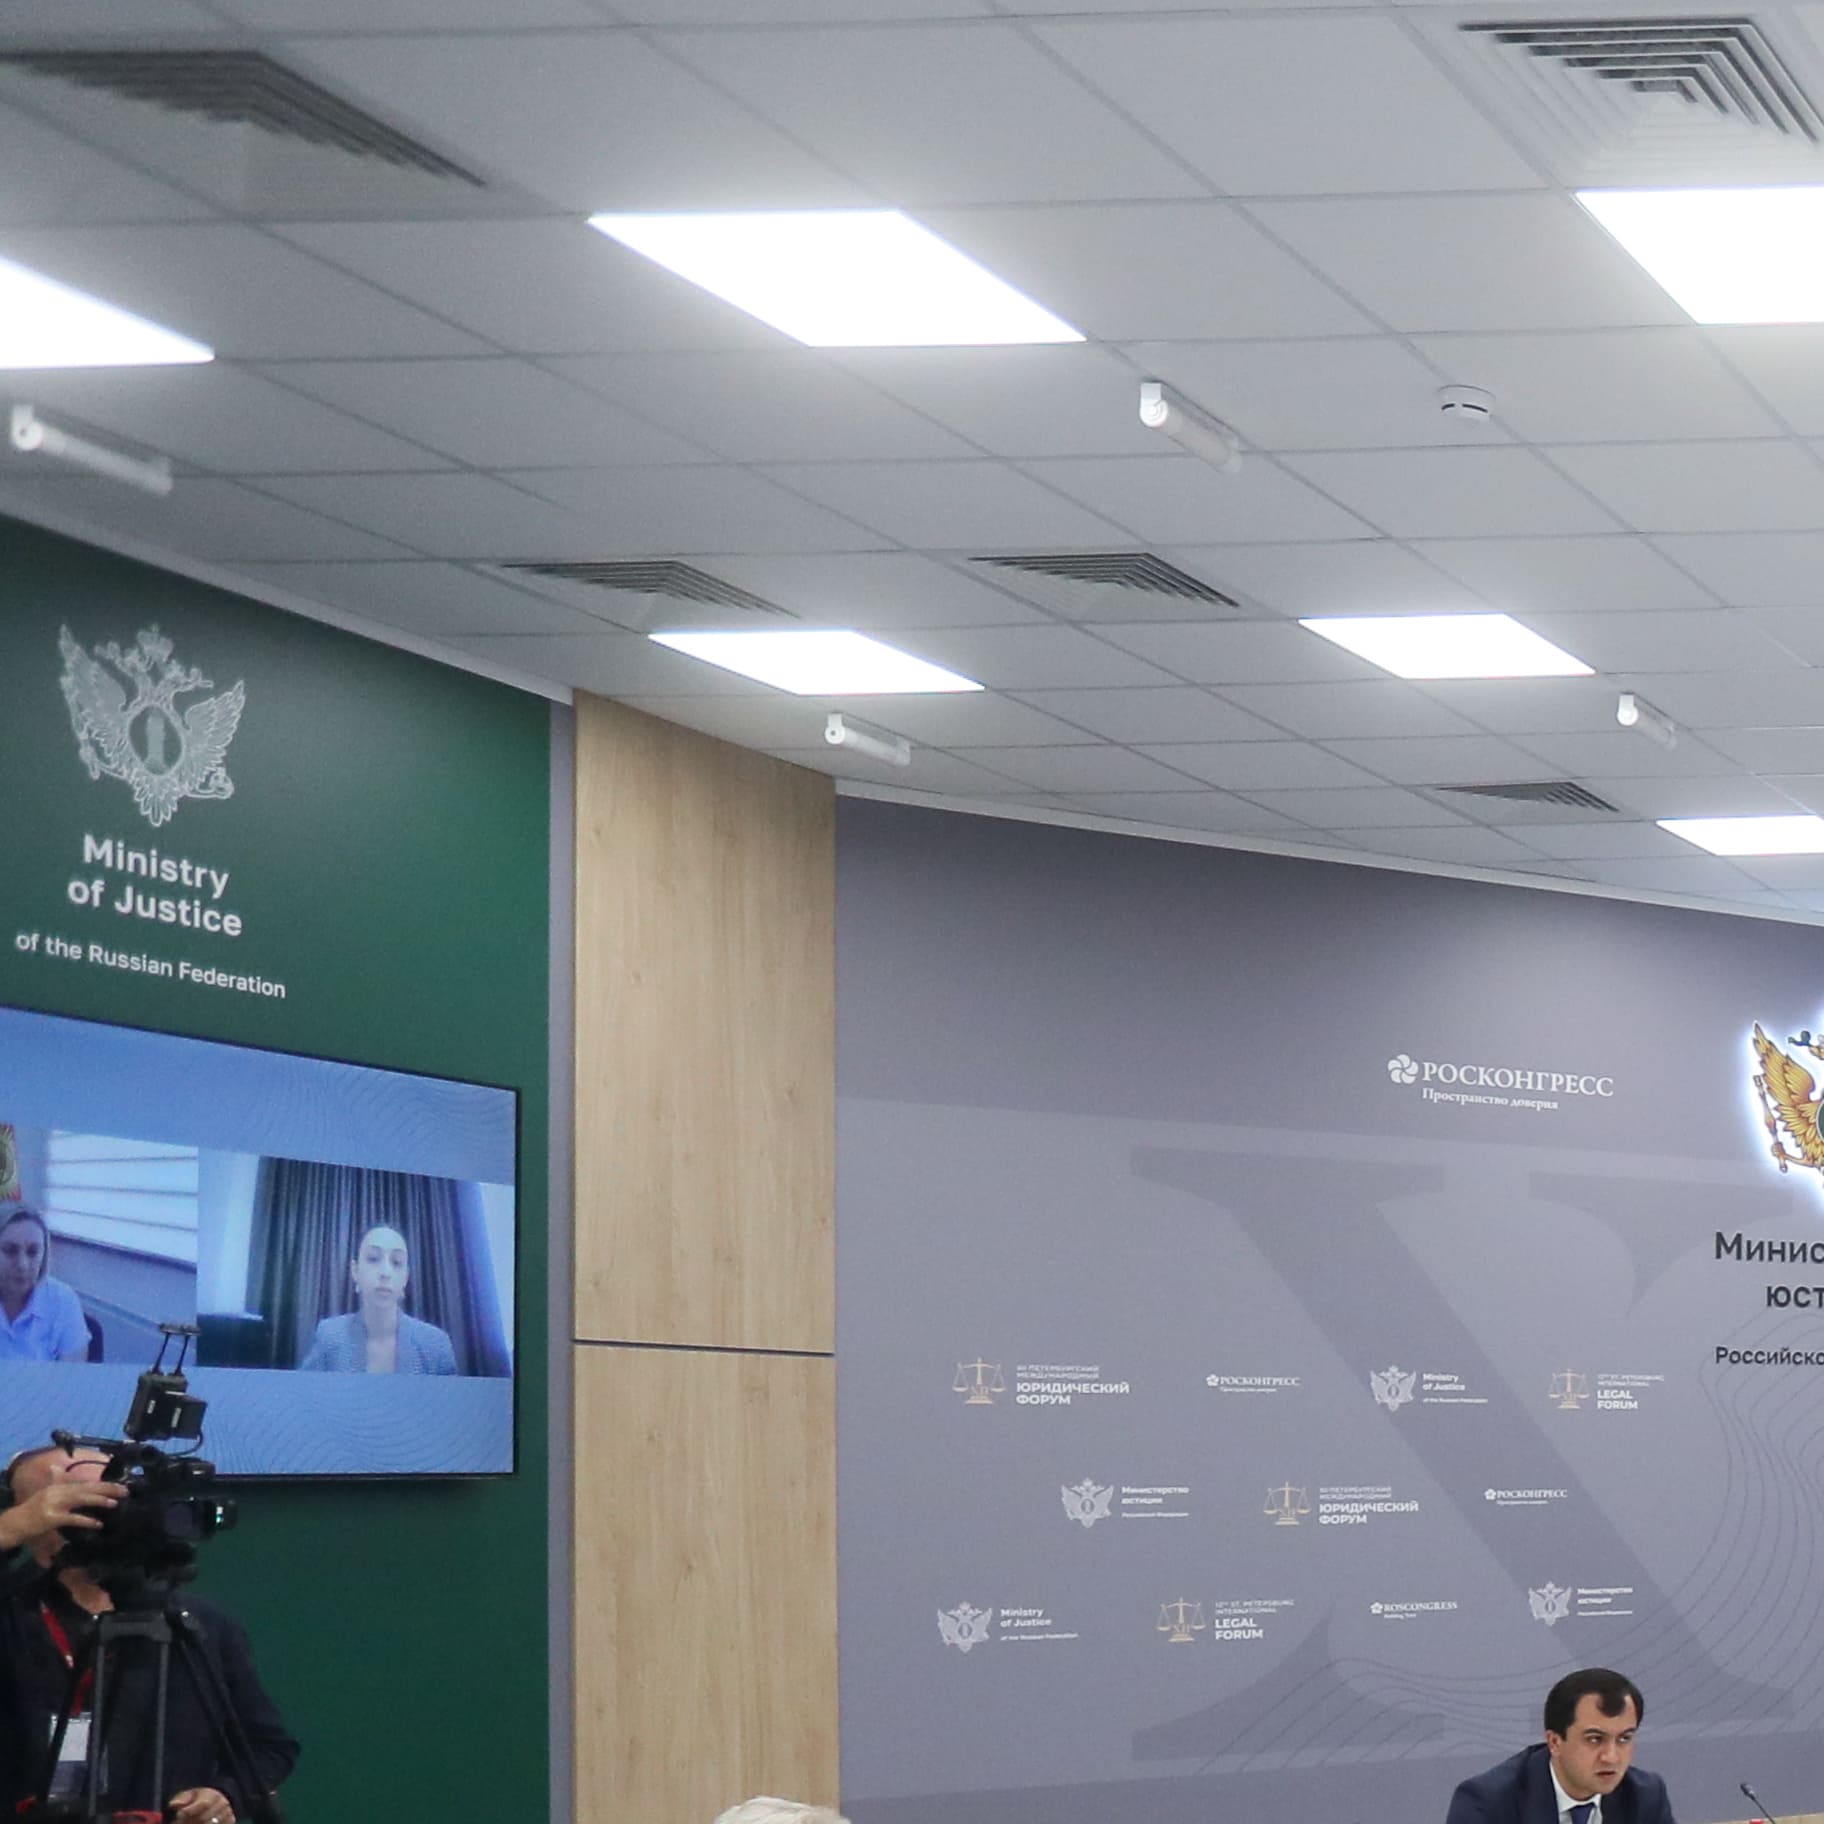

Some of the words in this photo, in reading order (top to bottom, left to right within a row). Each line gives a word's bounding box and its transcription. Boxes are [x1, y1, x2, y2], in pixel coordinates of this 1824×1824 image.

[84, 834, 229, 899] Ministry
[67, 879, 105, 908] of
[114, 886, 242, 936] Justice
[15, 932, 40, 951] of
[45, 936, 82, 960] the
[89, 944, 173, 977] Russian
[178, 961, 286, 999] Federation
[1422, 1062, 1614, 1097] РОСКОНГРЕСС
[1422, 1088, 1508, 1106] Пространство
[1510, 1097, 1558, 1111] доверия
[1017, 1381, 1130, 1393] ЮРИДИЧЕСКИЙ
[1016, 1394, 1071, 1405] ФОРУМ
[1597, 1390, 1633, 1399] LEGAL
[1597, 1400, 1638, 1409] FORUM
[1319, 1500, 1419, 1514] ЮРИДИЧЕСКИЙ
[1319, 1514, 1367, 1524] ФОРУМ
[1001, 1608, 1044, 1617] Ministry
[1215, 1618, 1257, 1628] LEGAL
[1215, 1629, 1263, 1640] FORUM
